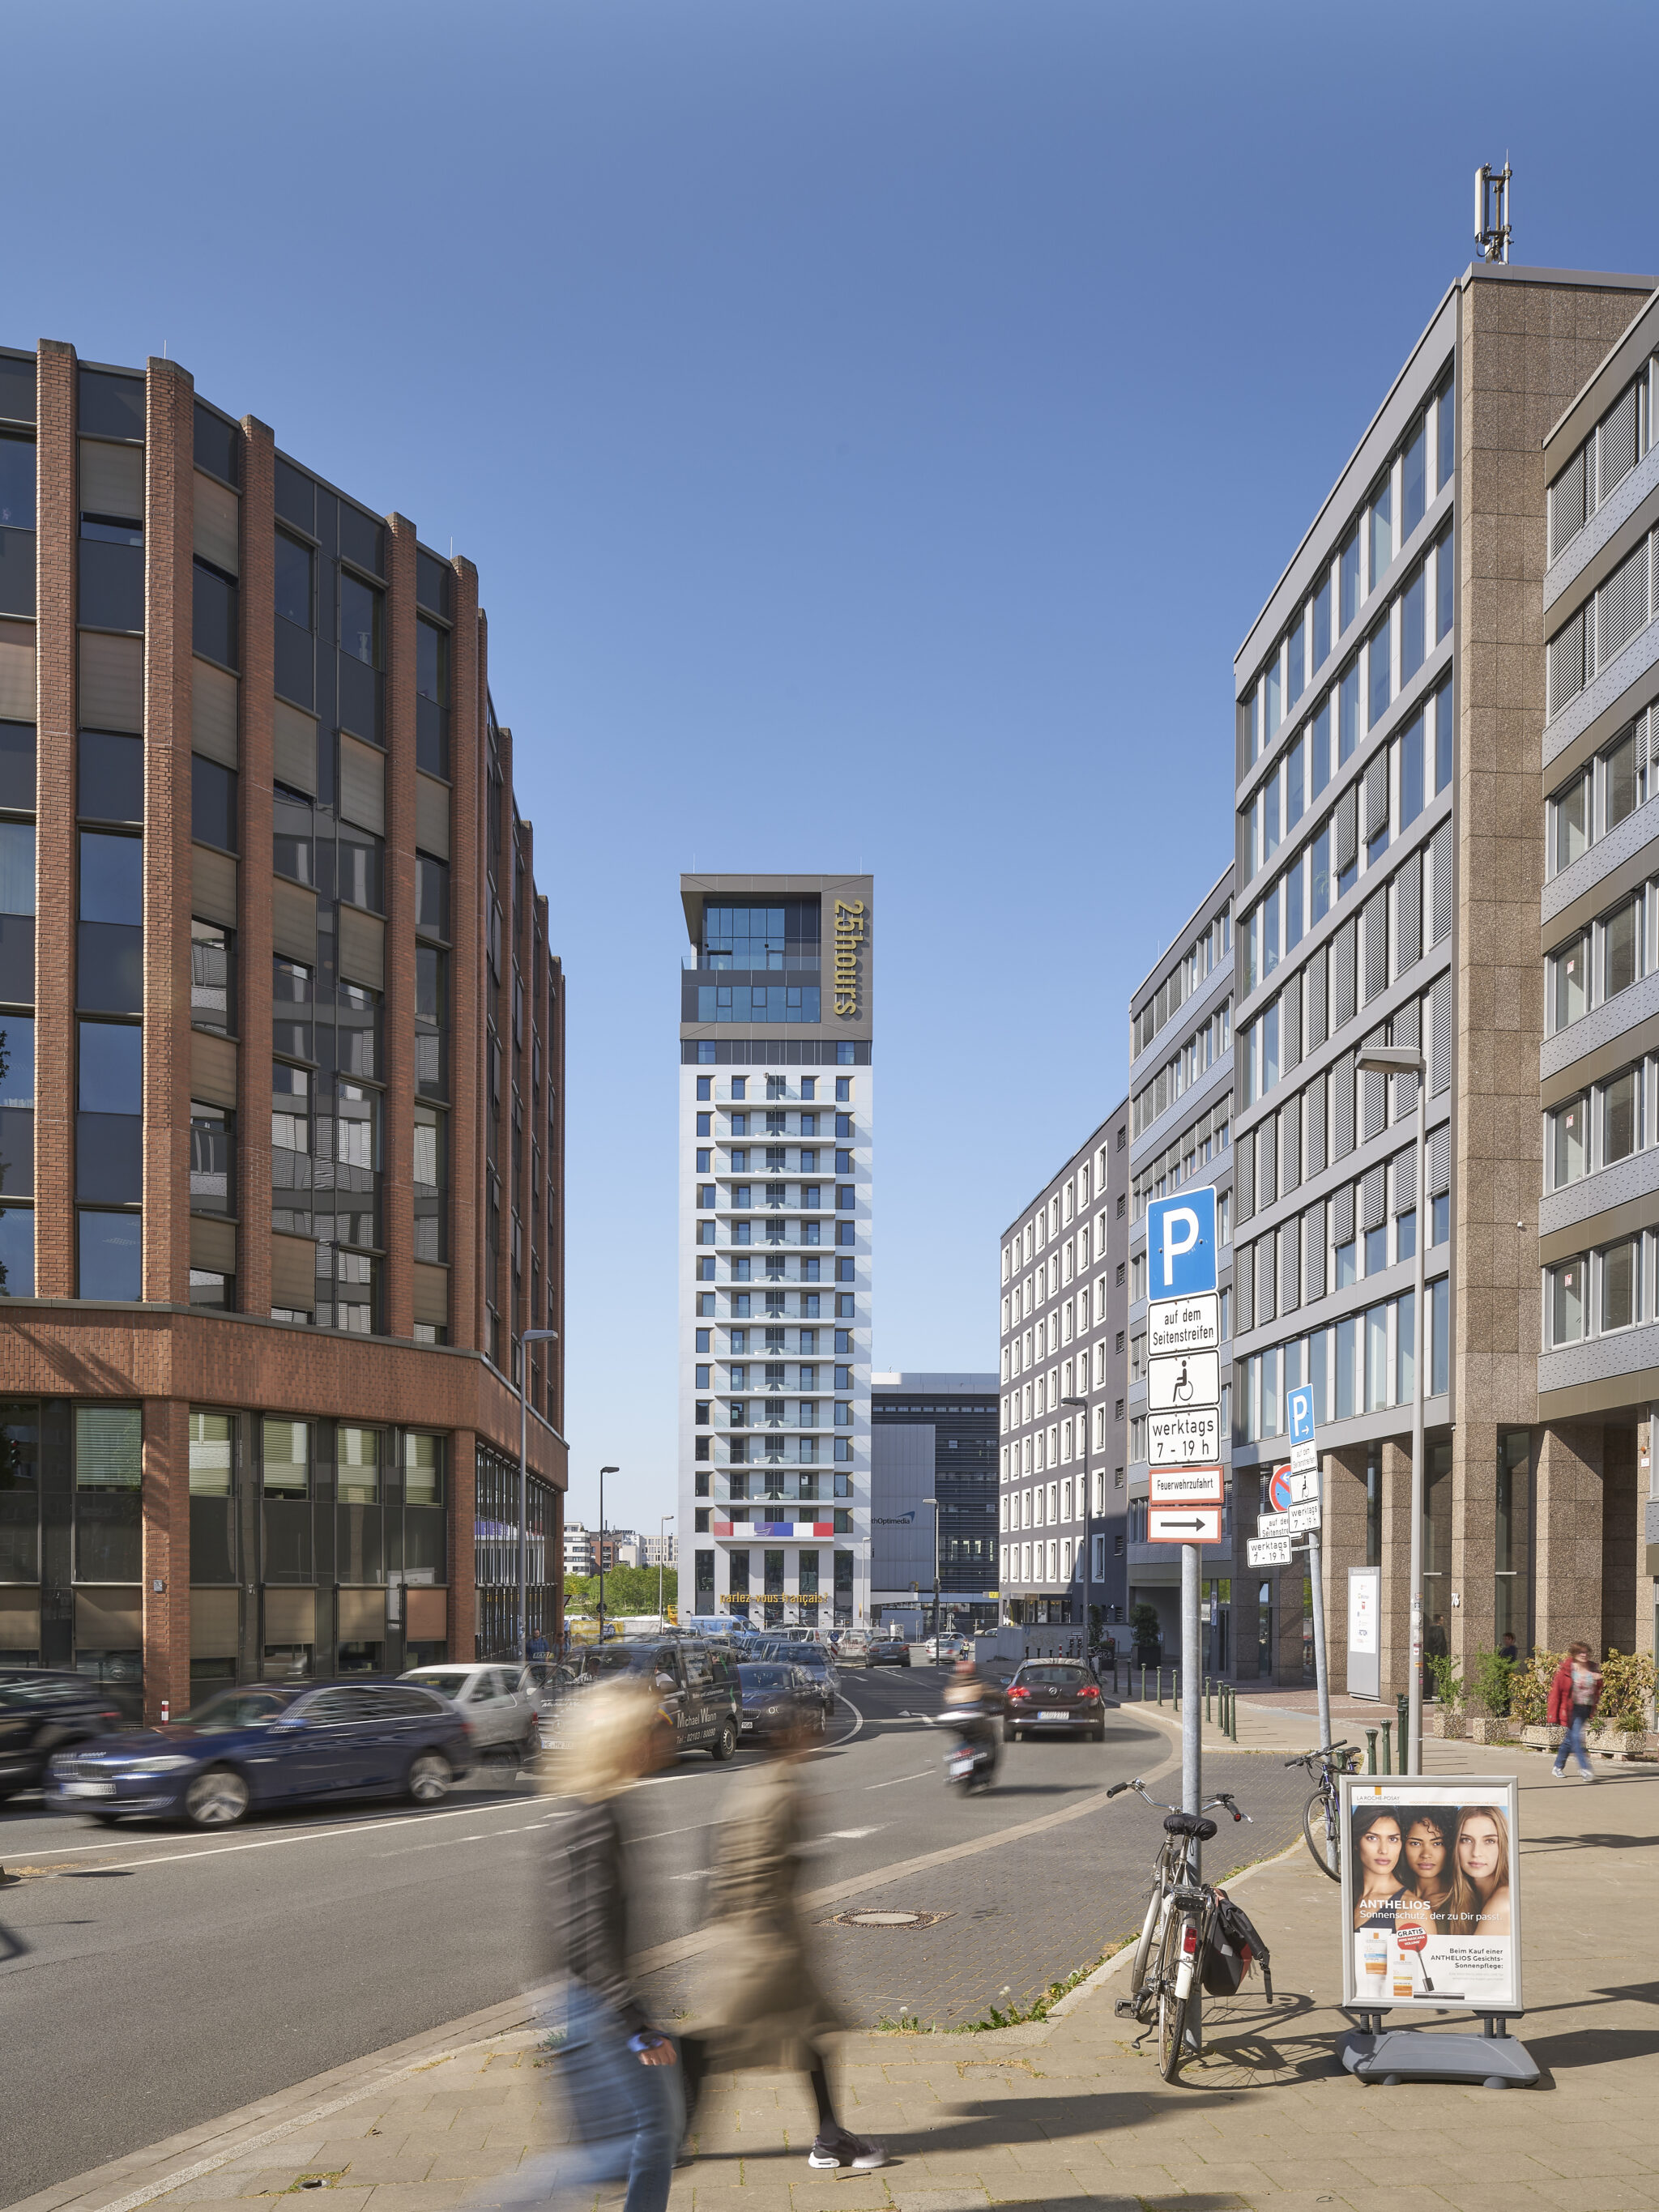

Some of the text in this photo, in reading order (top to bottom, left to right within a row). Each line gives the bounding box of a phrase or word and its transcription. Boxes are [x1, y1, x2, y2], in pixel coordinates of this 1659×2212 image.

[834, 899, 864, 1015] 25hours
[1162, 1207, 1199, 1285] P
[1165, 1308, 1201, 1325] auf dem
[1153, 1325, 1213, 1345] Seitenstreifen
[1294, 1396, 1307, 1437] P
[1153, 1419, 1213, 1436] werktags
[1158, 1443, 1163, 1458] 7
[1183, 1440, 1195, 1455] 19
[1202, 1439, 1209, 1455] h
[1158, 1478, 1213, 1490] Feuerwehrzufahrt
[1291, 1506, 1317, 1517] werktags
[871, 1517, 911, 1526] thOptimedia
[1269, 1515, 1289, 1527] auf de
[1262, 1527, 1289, 1538] Seitenstre
[1251, 1540, 1287, 1552] werktags
[1269, 1552, 1277, 1561] 19
[720, 1592, 828, 1605] parlez-vous français?
[677, 1707, 717, 1728] Michael Wann
[687, 1732, 701, 1742] 02103
[1359, 1899, 1431, 1910] ANTHELIOS
[1360, 1910, 1427, 1920] Sonnenschutz,
[1430, 1912, 1445, 1920] der
[1461, 1912, 1473, 1920] Dir
[1476, 1912, 1503, 1922] passt.
[1397, 1928, 1423, 1937] GRATIS
